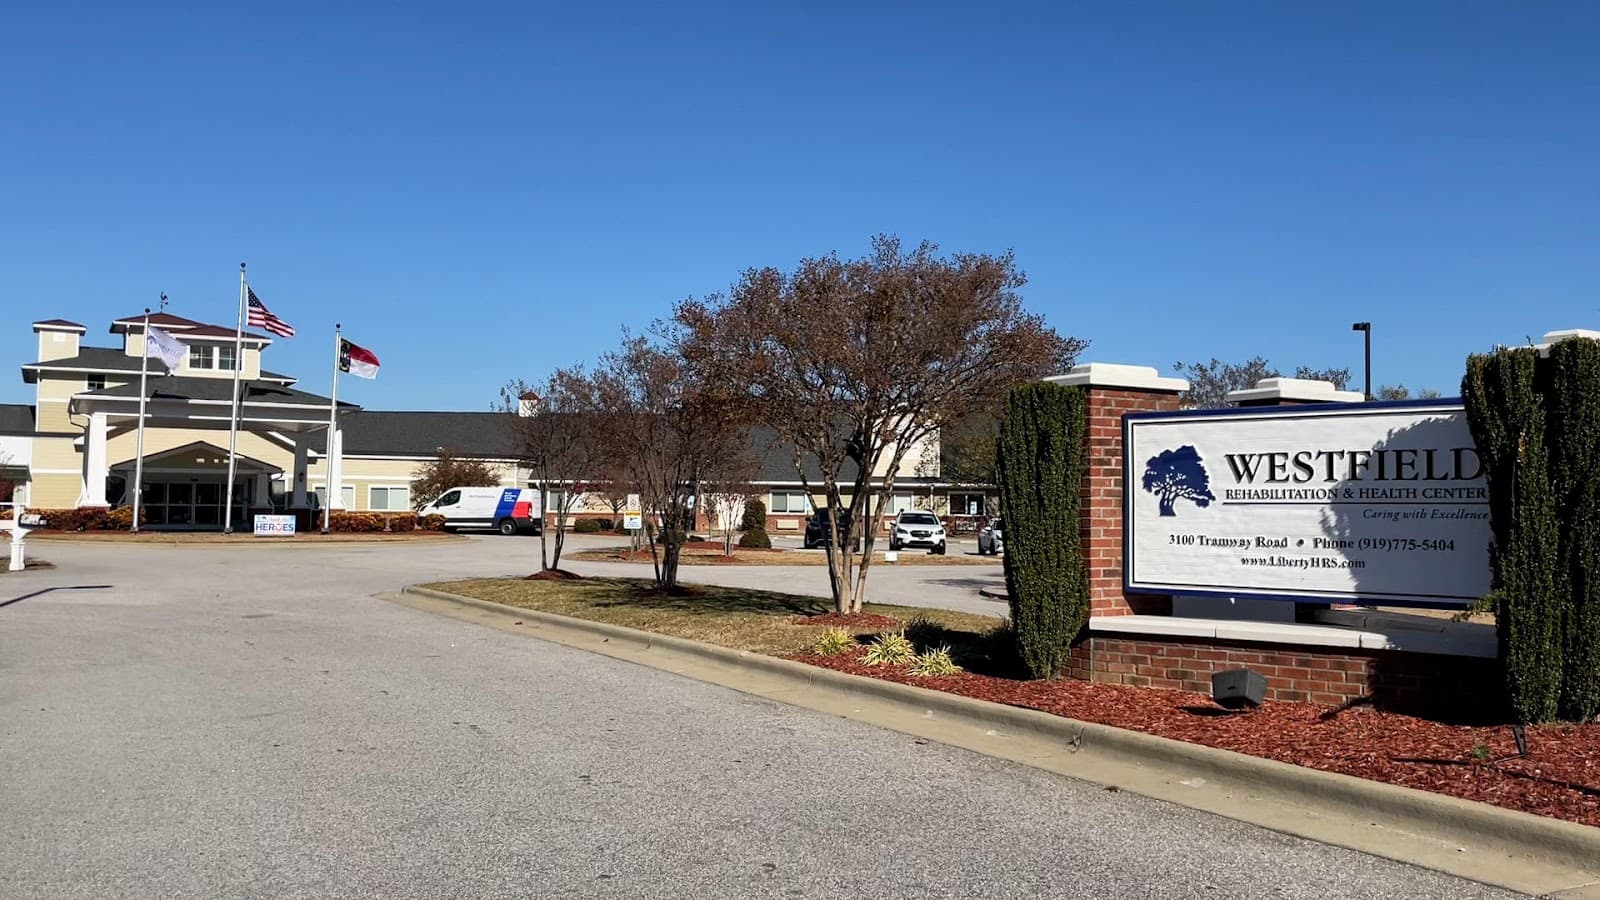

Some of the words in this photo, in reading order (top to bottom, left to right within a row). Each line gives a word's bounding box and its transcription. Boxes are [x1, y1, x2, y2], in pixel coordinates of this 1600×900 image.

[1224, 447, 1485, 484] WESTFIELD
[1225, 488, 1338, 500] REHABILITATION
[1343, 488, 1354, 499] &
[1359, 487, 1417, 499] HEALTH
[1422, 487, 1487, 499] CENTER
[1363, 508, 1400, 521] Caring
[1403, 508, 1427, 520] with
[1431, 508, 1488, 520] Excellence
[256, 523, 294, 532] HEROES
[1169, 534, 1195, 546] 3100
[1197, 535, 1252, 550] Tramway
[1255, 536, 1288, 548] Road
[1313, 537, 1354, 549] Phone
[1358, 538, 1455, 552] (919)775-5404
[1241, 556, 1365, 570] www.LibertyHRS.com
